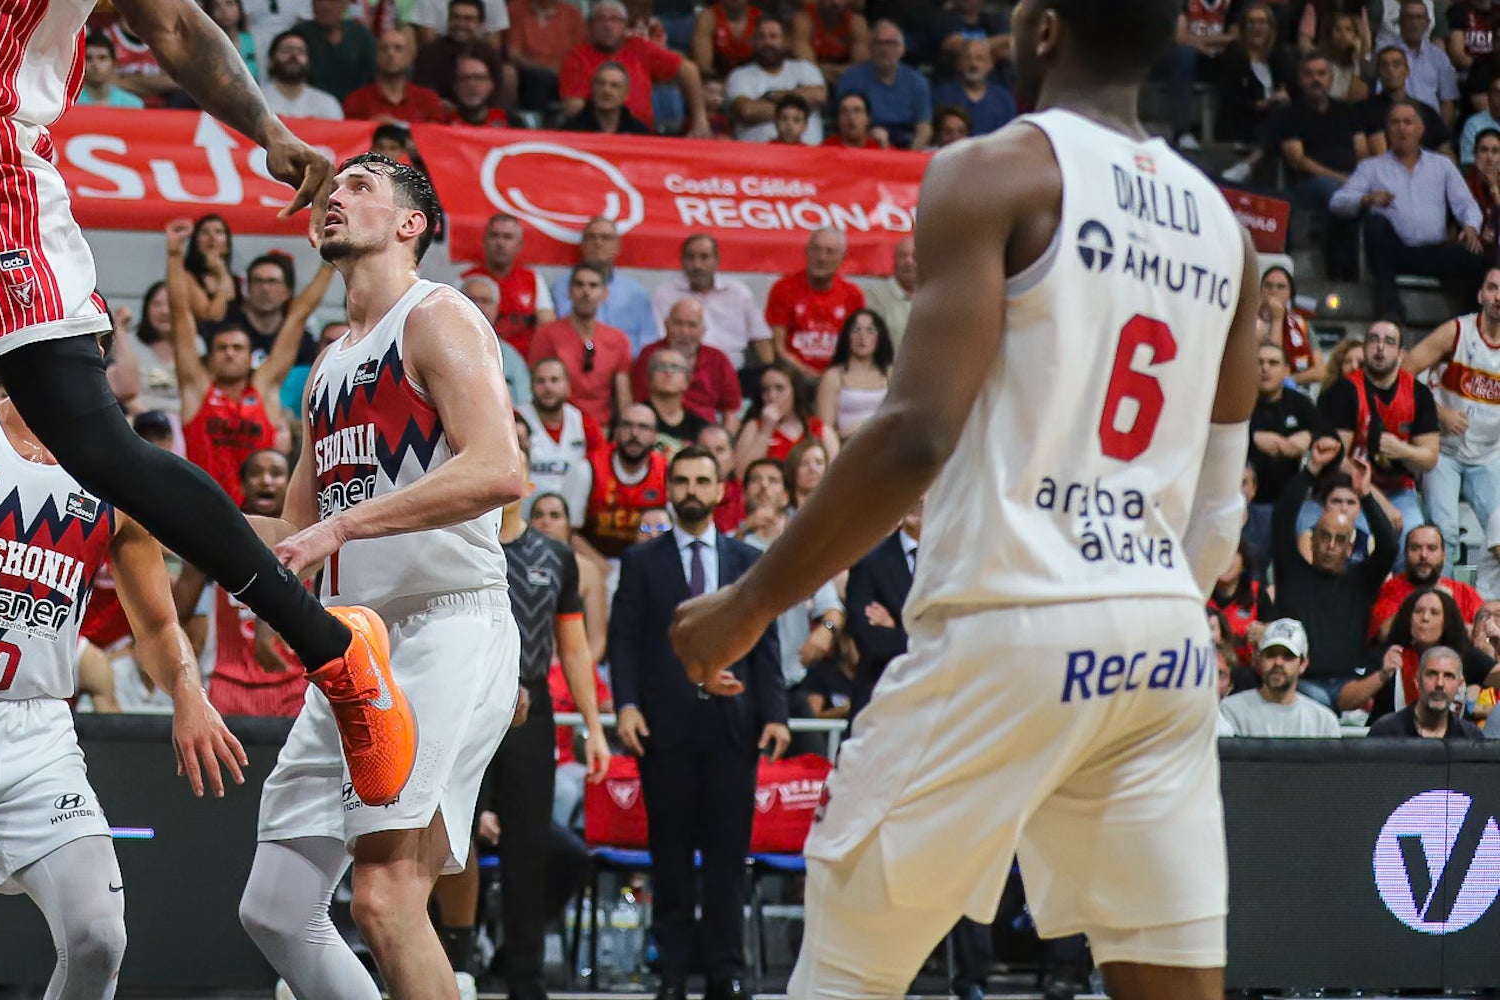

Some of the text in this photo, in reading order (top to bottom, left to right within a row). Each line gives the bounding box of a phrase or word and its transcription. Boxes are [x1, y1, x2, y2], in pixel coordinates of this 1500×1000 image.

[665, 174, 736, 196] Costa
[876, 202, 916, 232] D
[1, 257, 25, 269] acb
[1099, 313, 1178, 462] 6
[1080, 521, 1174, 569] álava
[28, 626, 58, 641] eficiente
[50, 808, 96, 826] HYUNDAI
